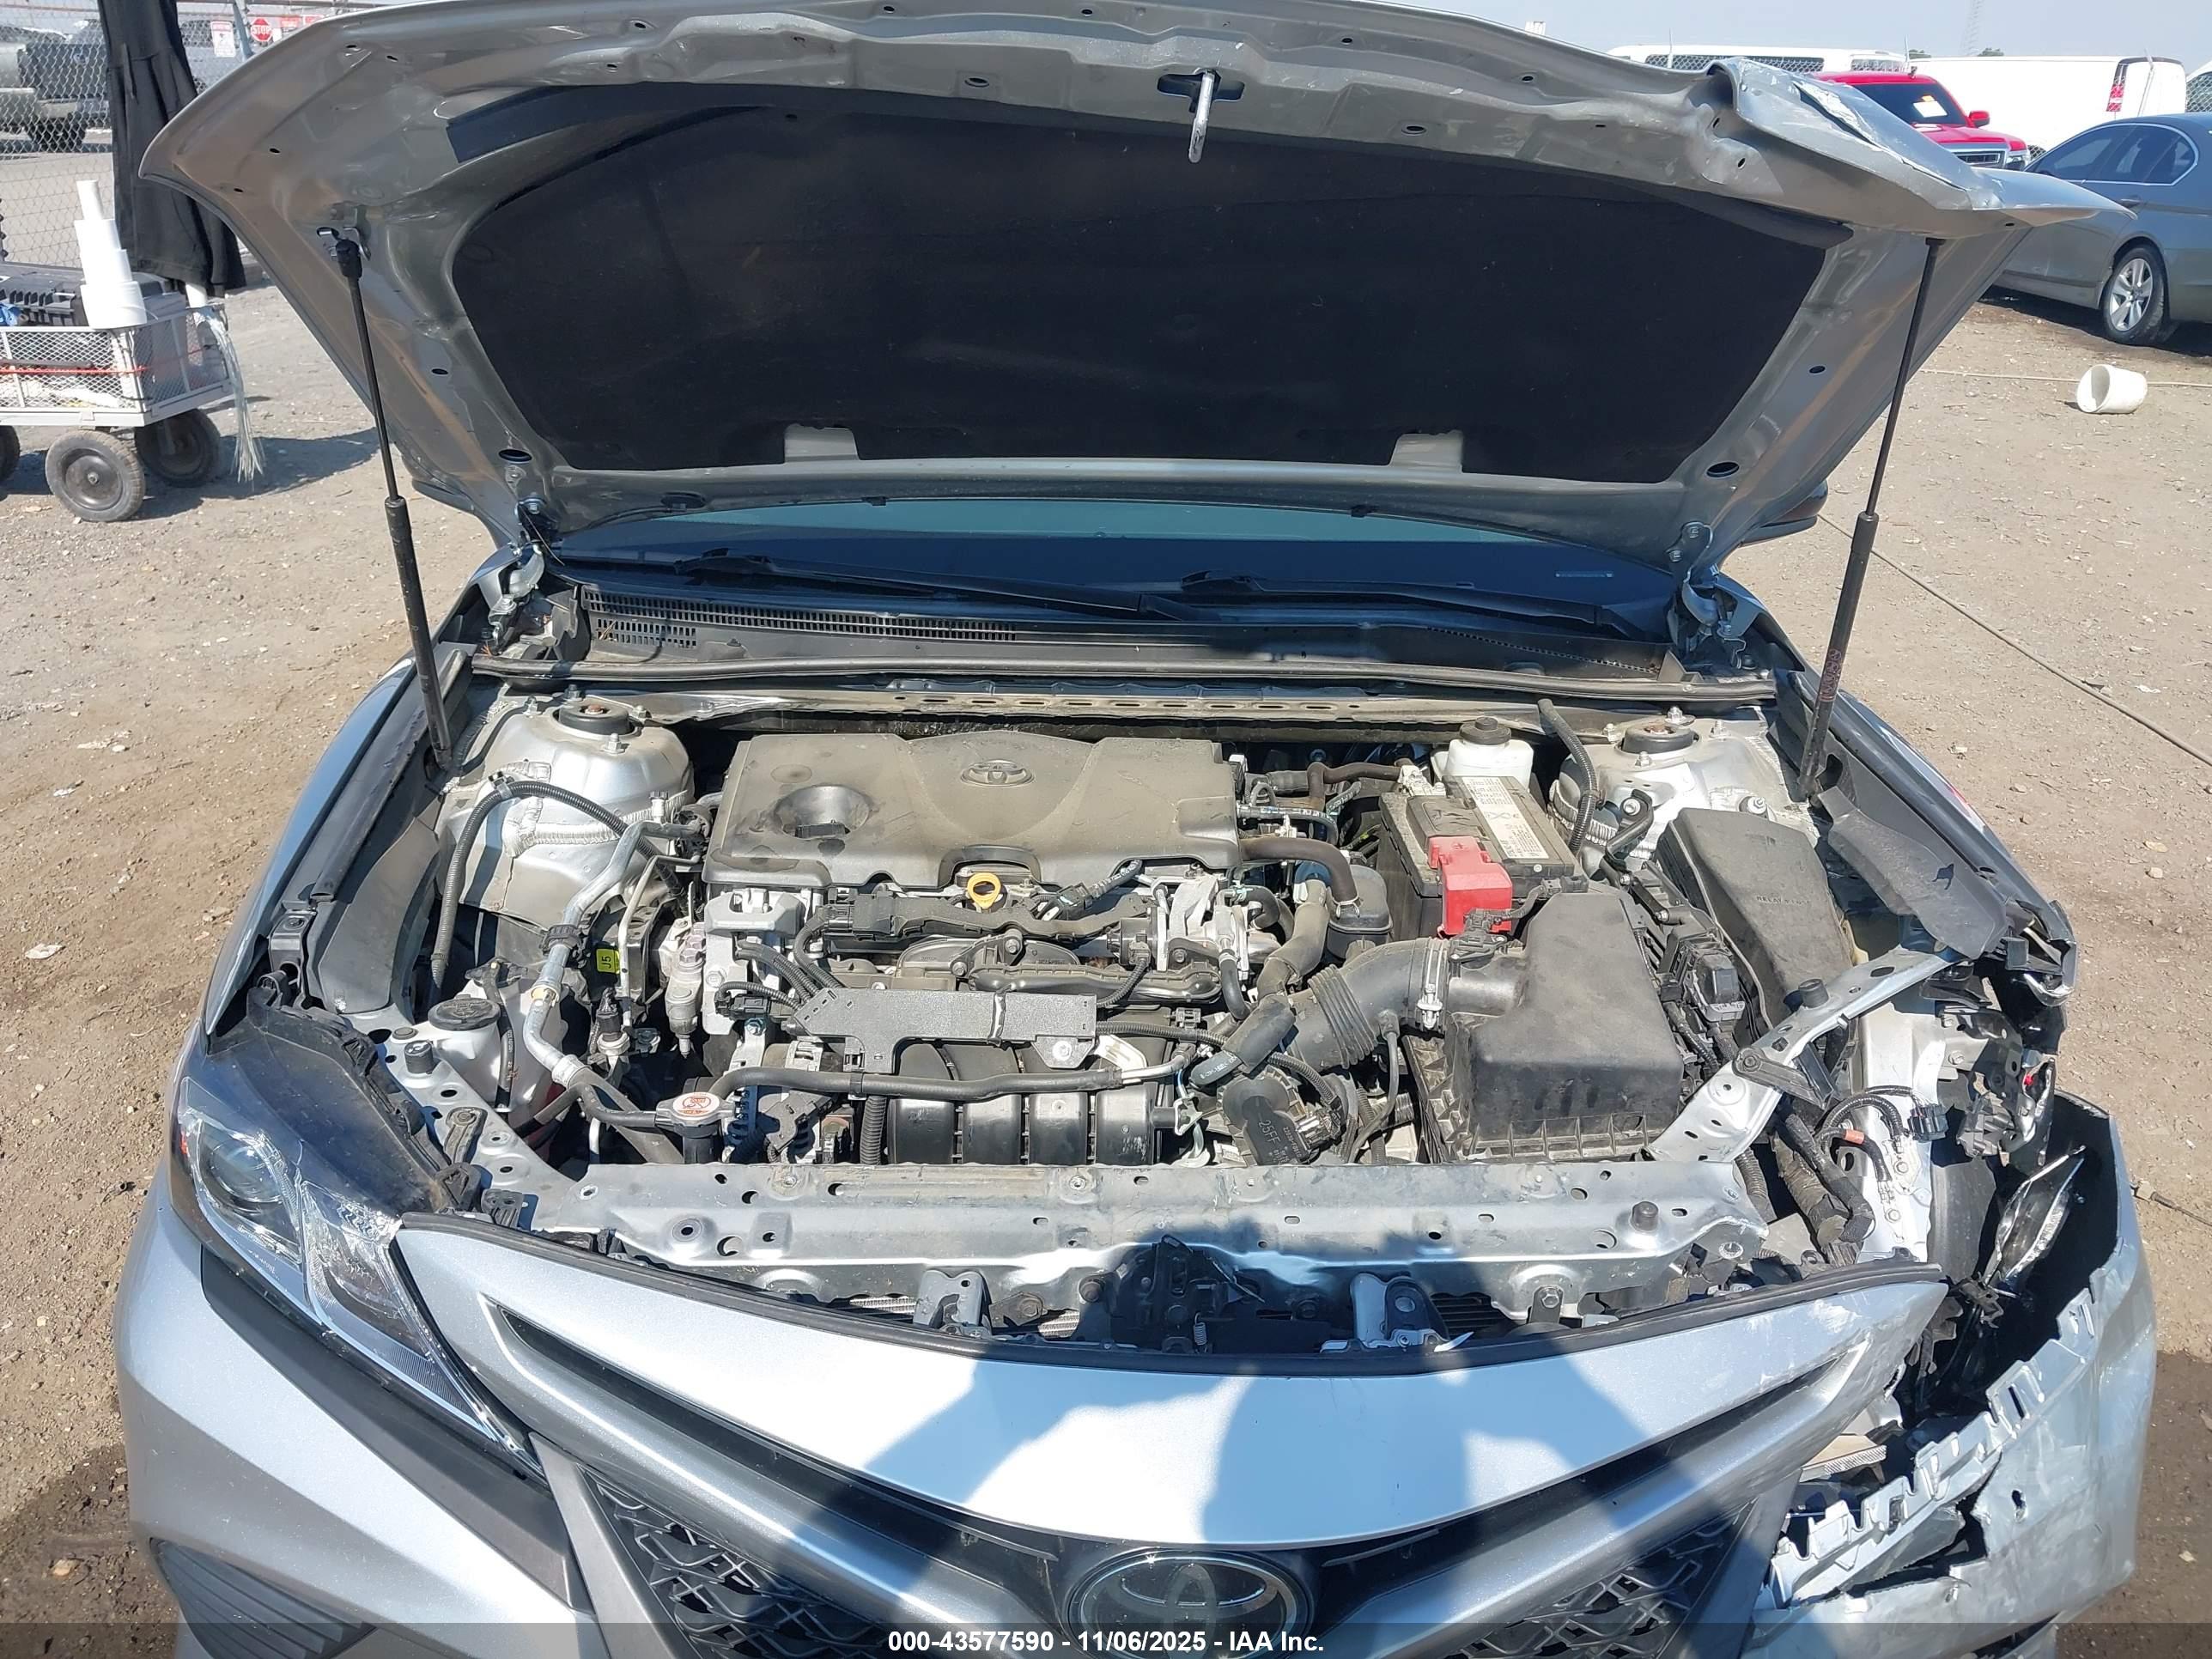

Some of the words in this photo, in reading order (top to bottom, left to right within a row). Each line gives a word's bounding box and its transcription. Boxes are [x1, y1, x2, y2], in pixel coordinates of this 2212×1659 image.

[251, 25, 272, 35] STOP
[601, 956, 611, 969] J5
[1258, 1120, 1281, 1144] 25FF
